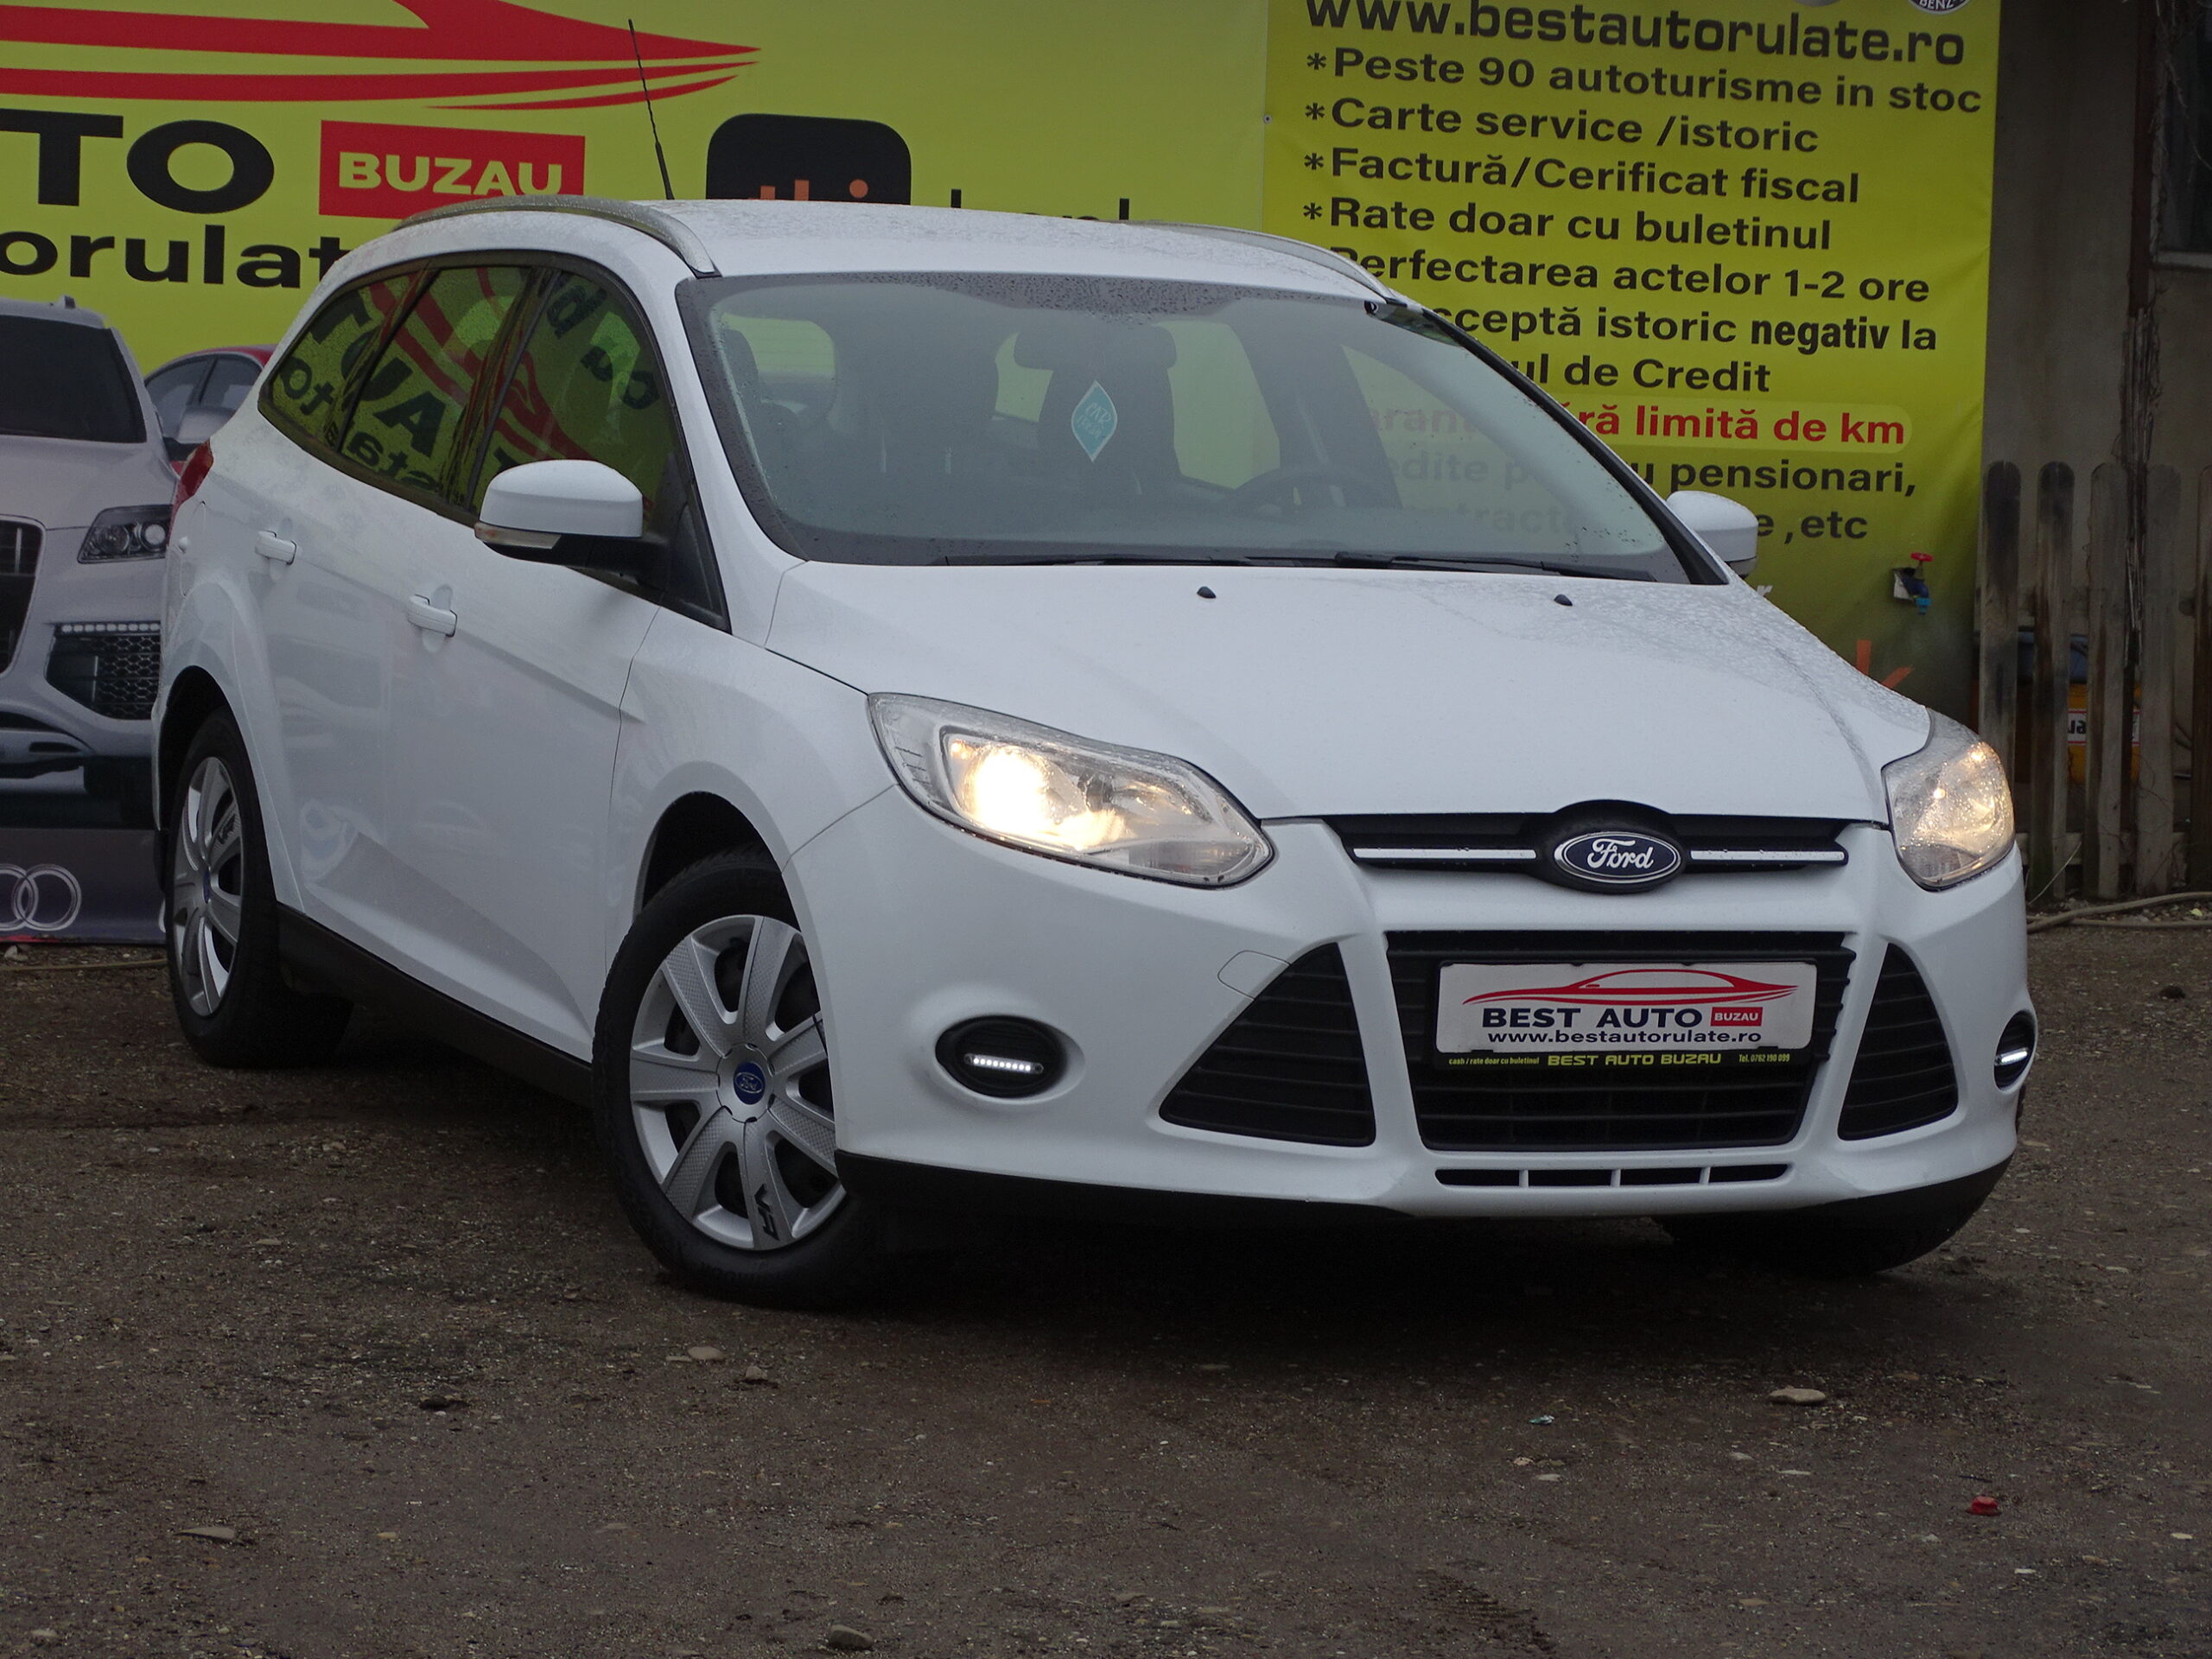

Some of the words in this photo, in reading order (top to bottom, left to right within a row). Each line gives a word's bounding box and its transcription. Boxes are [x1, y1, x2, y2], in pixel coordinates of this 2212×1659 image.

[1306, 0, 1966, 66] www.bestautorulate.ro
[1478, 56, 1535, 88] 90
[1548, 64, 1822, 105] autoturisme
[1836, 74, 1874, 108] in
[1888, 82, 1981, 113] stoc
[1475, 109, 1643, 143] service
[0, 108, 276, 215] TO
[338, 150, 563, 196] BUZAU
[1740, 167, 1859, 203] fiscal
[1448, 201, 1554, 237] doar
[1567, 215, 1619, 240] cu
[1636, 210, 1830, 250] buletinul
[1613, 263, 1771, 296] actelor
[1784, 269, 1845, 299] 1-2
[1859, 277, 1929, 302] ore
[1598, 306, 1737, 343] istoric
[1751, 315, 1890, 355] negativ
[1901, 319, 1936, 351] la
[1564, 354, 1618, 387] de
[1633, 359, 1770, 392] Credit
[1637, 405, 1758, 439] limită
[1774, 410, 1826, 442] de
[1841, 412, 1904, 443] km
[1666, 461, 1916, 499] pensionari,
[1587, 838, 1654, 868] Ford
[1482, 1007, 1580, 1027] BEST
[1596, 1007, 1702, 1027] AUTO
[1713, 1010, 1759, 1021] BUZAU
[1488, 1029, 1762, 1043] www.bestautorulate.ro
[1448, 1057, 1465, 1065] cash
[1548, 1055, 1599, 1066] BEST
[1605, 1054, 1654, 1065] AUTO
[1661, 1053, 1721, 1065] BUZAU
